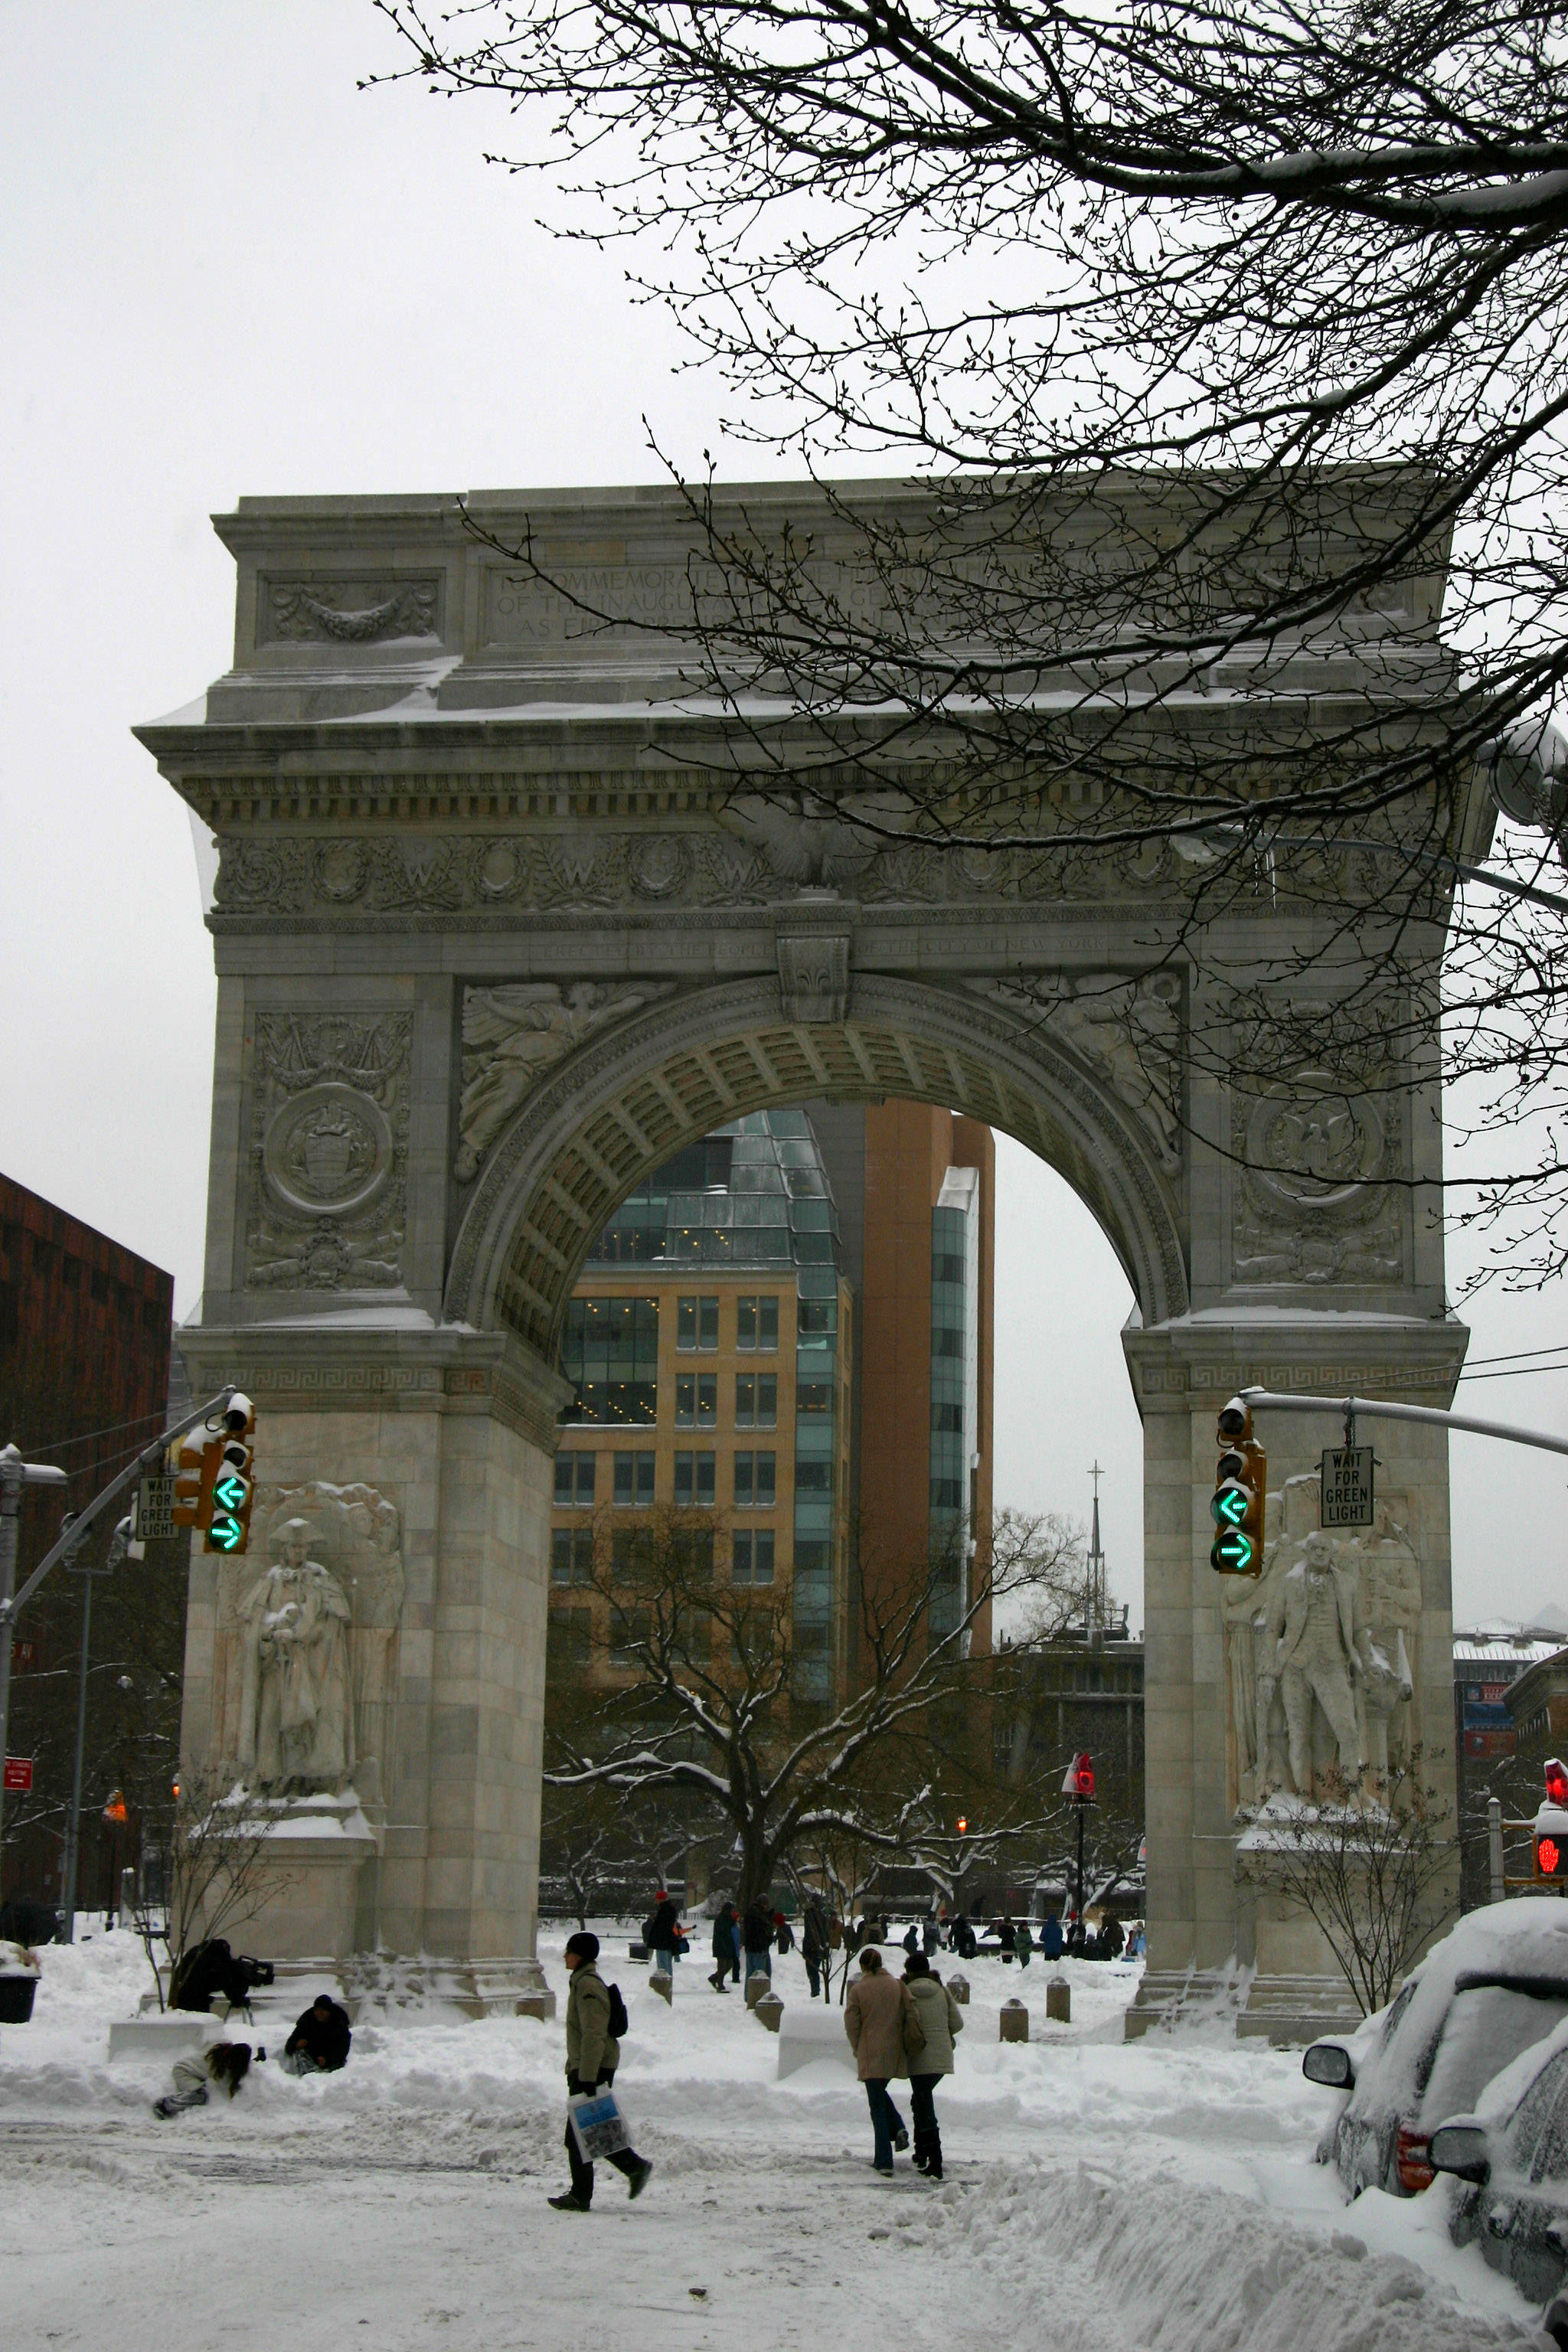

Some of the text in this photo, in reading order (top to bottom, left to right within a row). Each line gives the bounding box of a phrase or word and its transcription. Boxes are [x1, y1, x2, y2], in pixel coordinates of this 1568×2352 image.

[497, 573, 527, 591] TO
[533, 569, 720, 592] COMMEMORATE
[498, 596, 531, 614] OF
[521, 619, 550, 636] AS
[1332, 1452, 1362, 1468] WAIT
[148, 1479, 174, 1492] WAIT
[1335, 1471, 1359, 1485] FOR
[149, 1494, 171, 1507] FOR
[1326, 1488, 1367, 1504] GREEN
[1329, 1505, 1365, 1521] LIGHT
[143, 1523, 175, 1536] LIGHT
